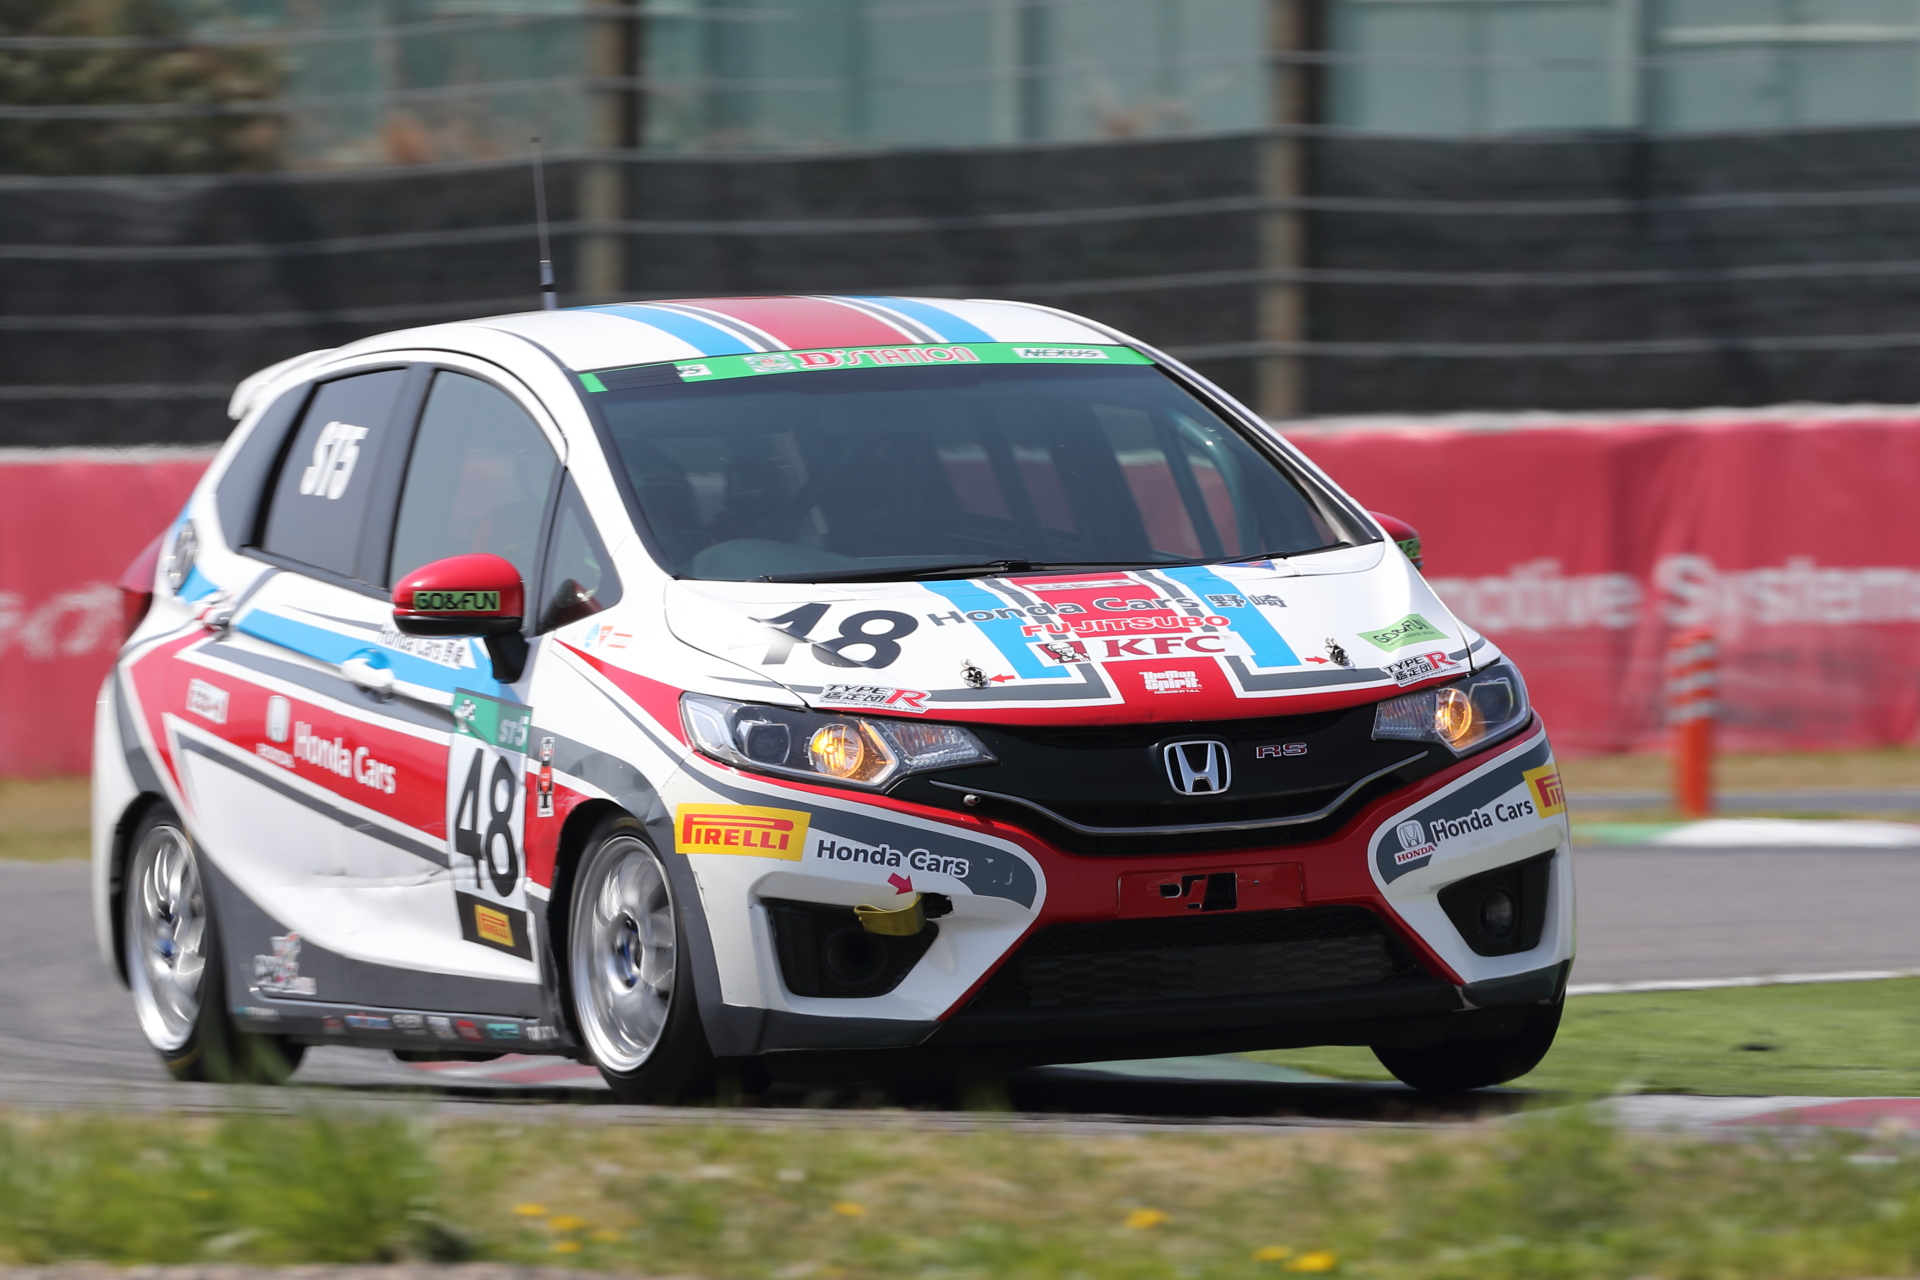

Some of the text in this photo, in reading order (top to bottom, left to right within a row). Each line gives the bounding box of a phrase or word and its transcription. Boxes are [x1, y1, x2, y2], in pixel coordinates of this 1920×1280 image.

[1023, 349, 1098, 358] NEXUS
[299, 421, 369, 500] ST5
[416, 592, 498, 611] GO&FUN
[926, 594, 1288, 626] Honda Cars 野崎
[748, 602, 919, 669] 48
[1021, 615, 1231, 637] FUJITSUBO
[1104, 636, 1226, 658] KFC
[1386, 651, 1456, 673] TYPE R
[827, 684, 927, 709] TYPE R
[499, 716, 529, 747] ST5
[294, 720, 397, 794] Honda Cars
[1256, 742, 1308, 759] RS
[455, 747, 519, 898] 48
[682, 814, 795, 850] PIRELLI
[1431, 800, 1534, 843] Honda Cars
[816, 839, 967, 877] Honda Cars
[1396, 844, 1436, 863] HONDA
[478, 911, 509, 939] PIRELLI
